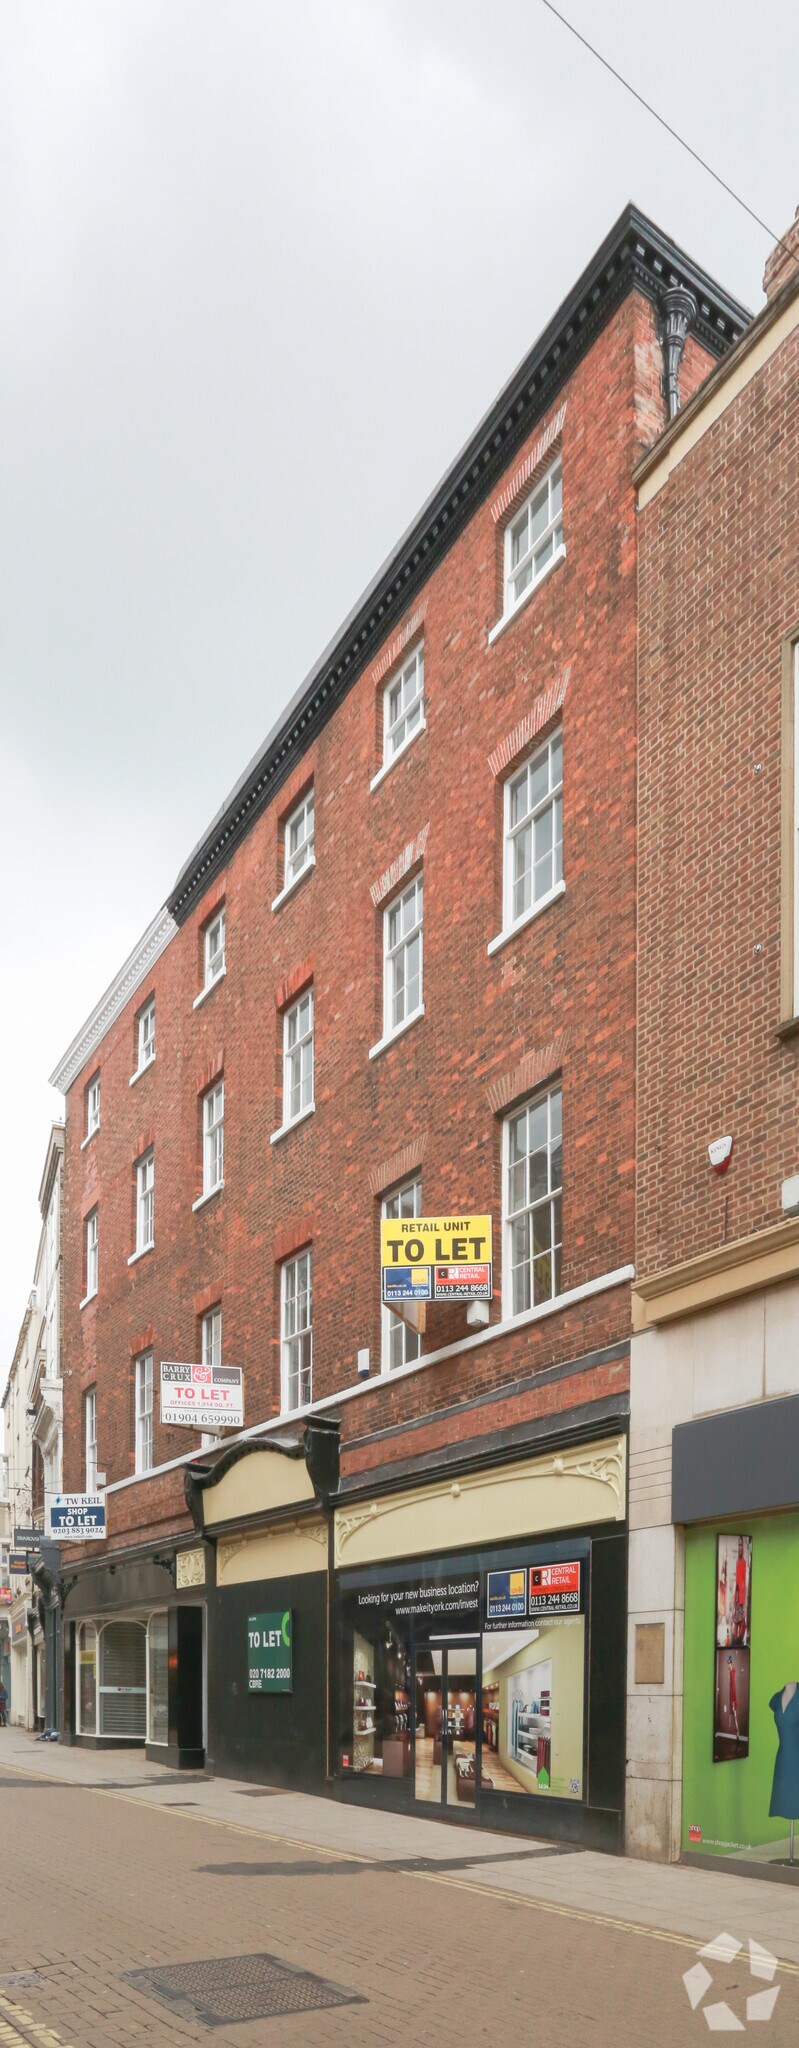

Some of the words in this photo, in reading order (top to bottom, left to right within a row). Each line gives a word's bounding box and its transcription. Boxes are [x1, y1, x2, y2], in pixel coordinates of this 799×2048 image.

[402, 1224, 439, 1232] RETAIL
[444, 1222, 470, 1231] UNIT
[387, 1239, 424, 1262] TO
[435, 1237, 486, 1260] LET
[163, 1365, 190, 1374] BARRY
[194, 1367, 210, 1382] &
[163, 1373, 190, 1381] CRUX
[174, 1388, 195, 1398] TO
[201, 1389, 230, 1400] LET
[165, 1413, 197, 1423] 01904
[201, 1414, 240, 1424] 659990
[59, 1516, 74, 1526] TO
[78, 1516, 97, 1526] LET
[551, 1566, 576, 1576] CENTRAL
[551, 1576, 570, 1584] RETAIL
[358, 1593, 380, 1605] Looking
[381, 1592, 389, 1602] for
[390, 1592, 404, 1603] your
[405, 1590, 418, 1600] new
[420, 1587, 447, 1598] business
[448, 1581, 479, 1595] location?
[530, 1595, 546, 1606] 0113
[548, 1594, 560, 1604] 244
[561, 1592, 578, 1603] 8668
[395, 1598, 478, 1615] www.makeityork.com/invest
[490, 1604, 501, 1613] 0113
[512, 1603, 524, 1611] 0100
[249, 1632, 260, 1648] TO
[263, 1630, 281, 1648] LET
[249, 1669, 259, 1678] 020
[260, 1668, 275, 1678] 7182
[276, 1668, 290, 1678] 2000
[249, 1680, 262, 1688] CBRE
[689, 1824, 700, 1832] Shop
[702, 1839, 752, 1850] www.shopjacket.co.uk
